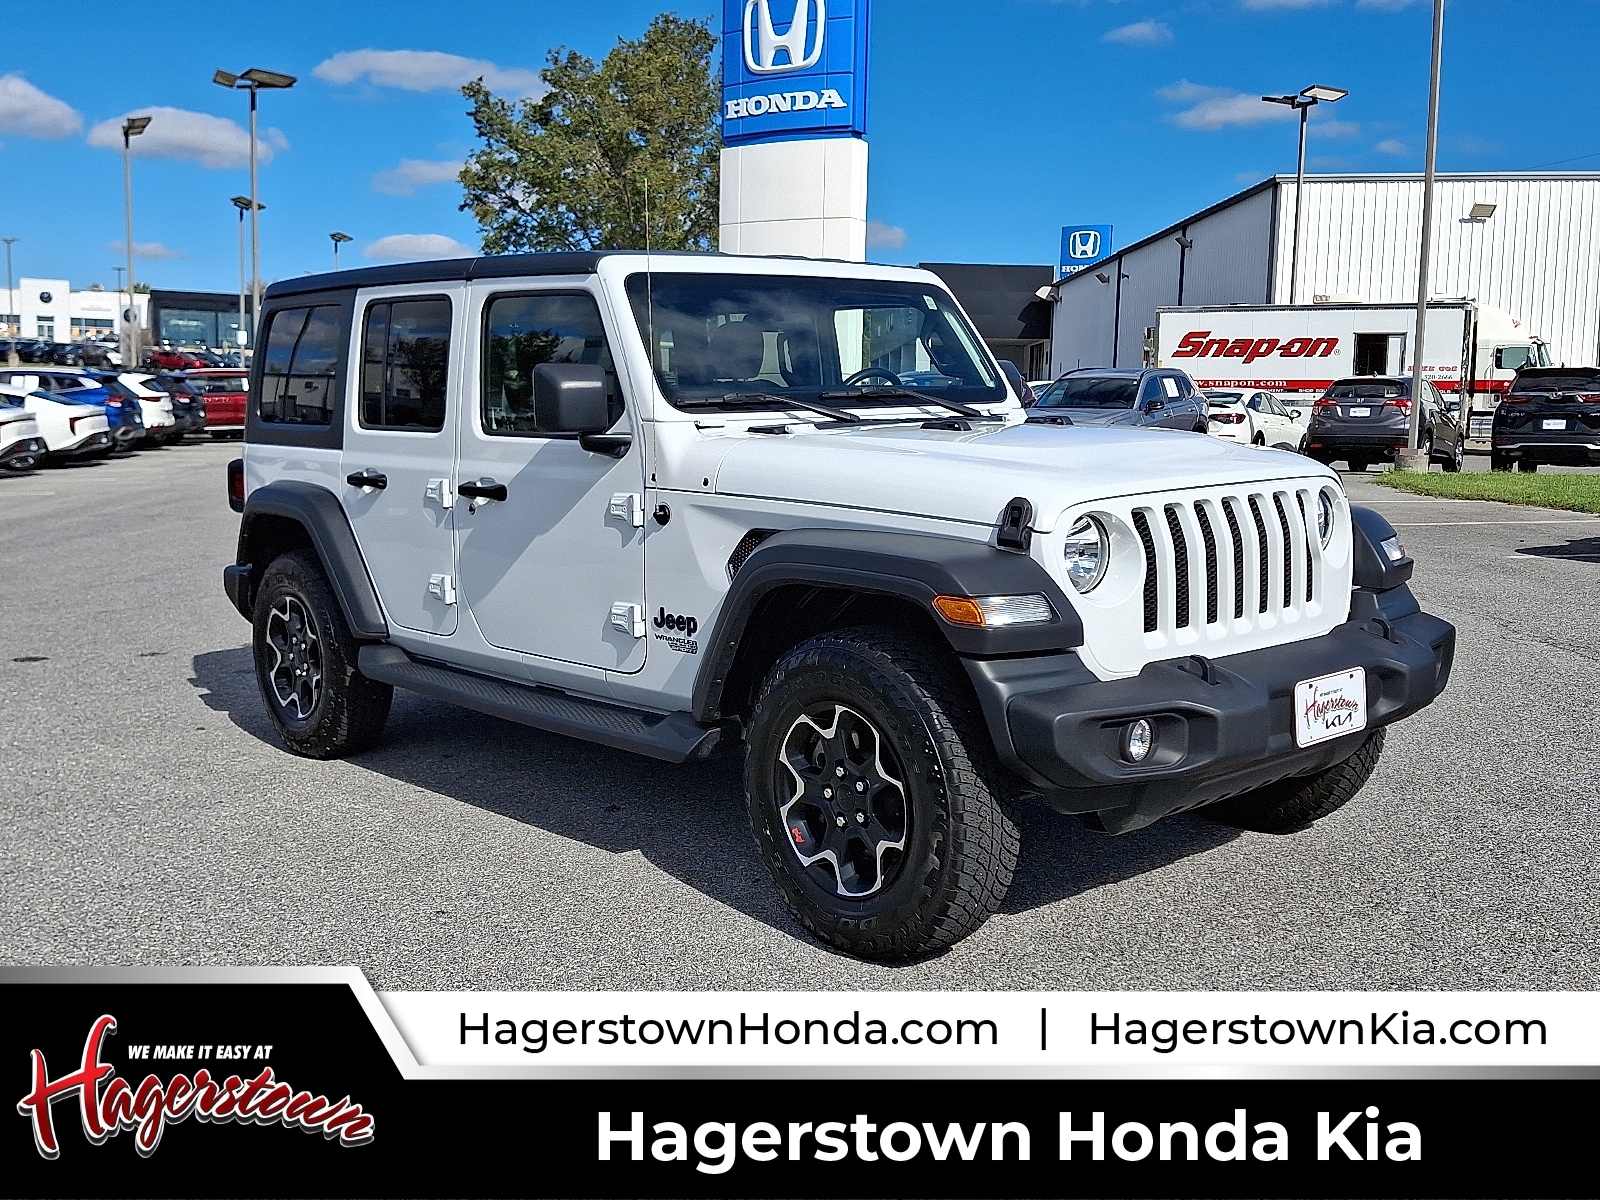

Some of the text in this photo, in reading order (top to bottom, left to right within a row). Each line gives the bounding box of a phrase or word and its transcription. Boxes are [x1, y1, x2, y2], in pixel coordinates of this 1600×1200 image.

[726, 89, 847, 119] HONDA
[1061, 265, 1090, 273] HON
[653, 607, 697, 637] Jeep
[654, 633, 698, 646] WRANGLER
